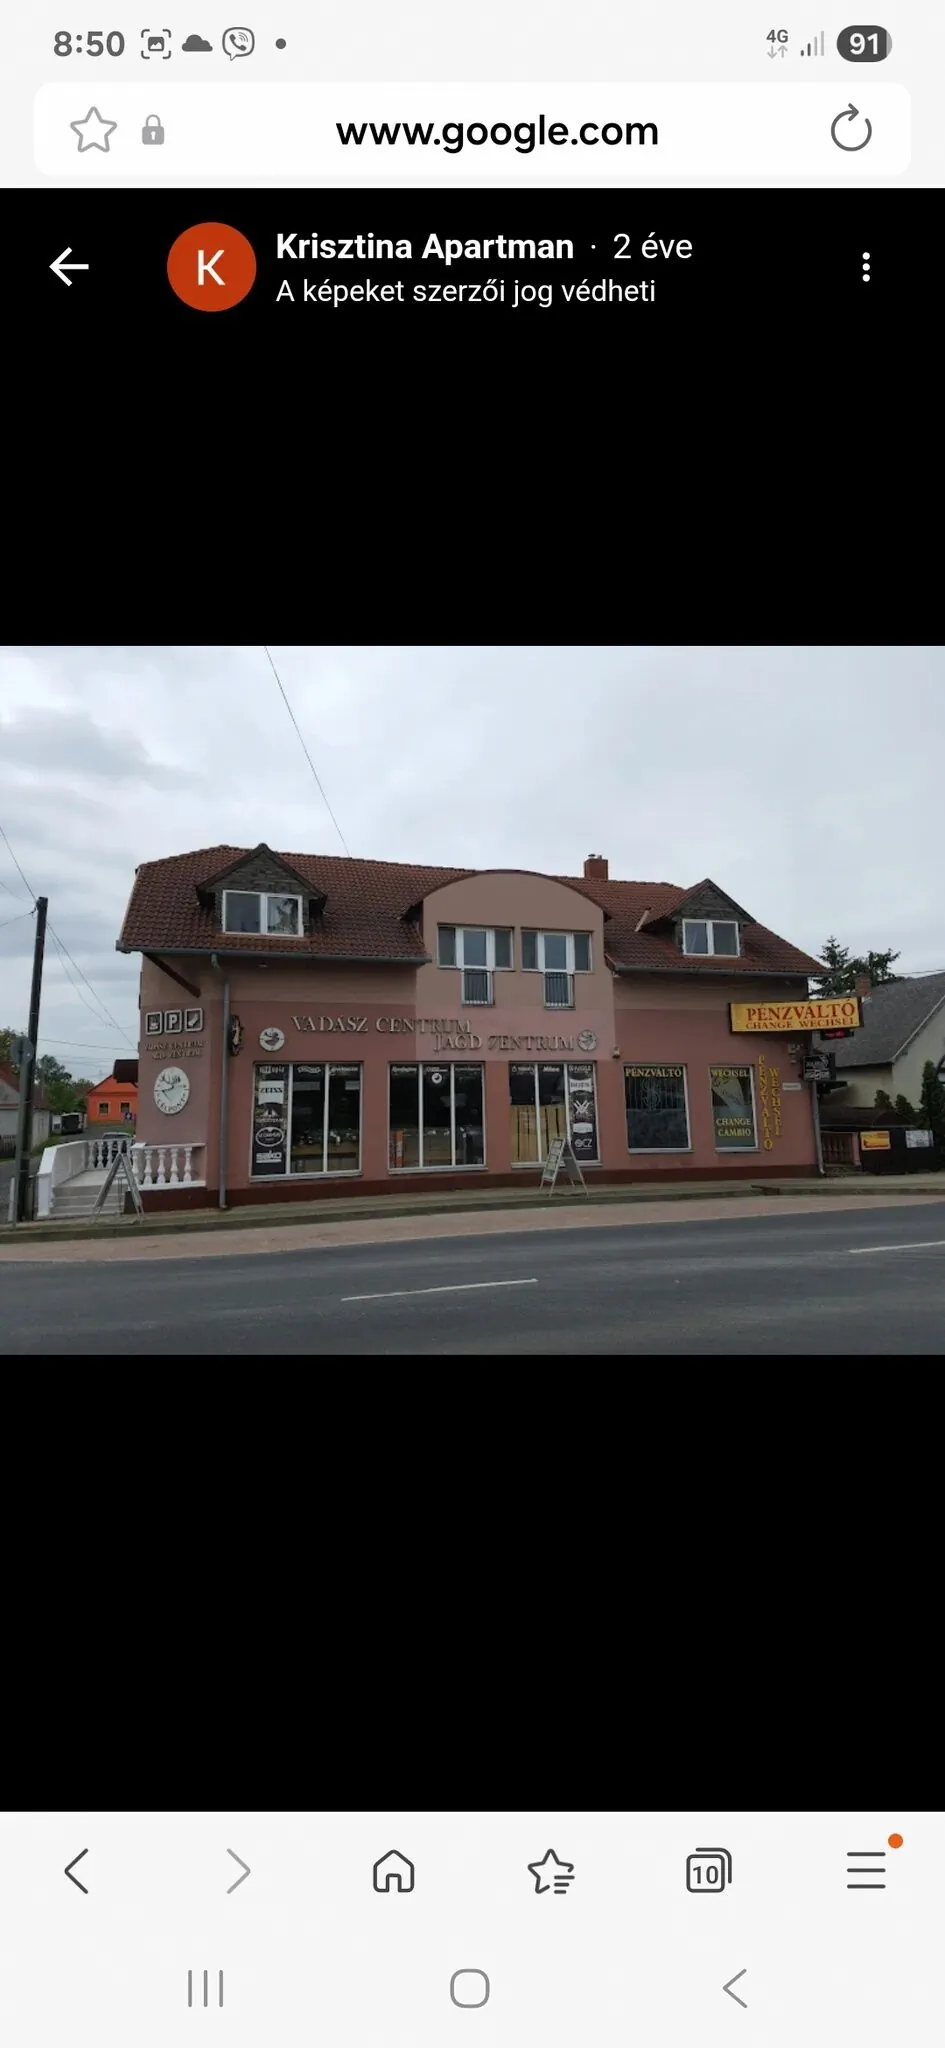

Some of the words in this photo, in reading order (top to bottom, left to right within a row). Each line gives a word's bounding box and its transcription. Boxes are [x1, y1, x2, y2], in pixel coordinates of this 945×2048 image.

[745, 998, 855, 1021] PÉNZVÁLTÓ
[291, 1014, 369, 1033] VADÁSZ
[376, 1016, 473, 1035] CENTRUM
[745, 1020, 793, 1031] CHANGE
[434, 1033, 483, 1053] JAGD
[488, 1034, 574, 1051] ZENTRUM
[716, 1117, 751, 1127] CHANGE
[717, 1128, 752, 1137] CAMBIO
